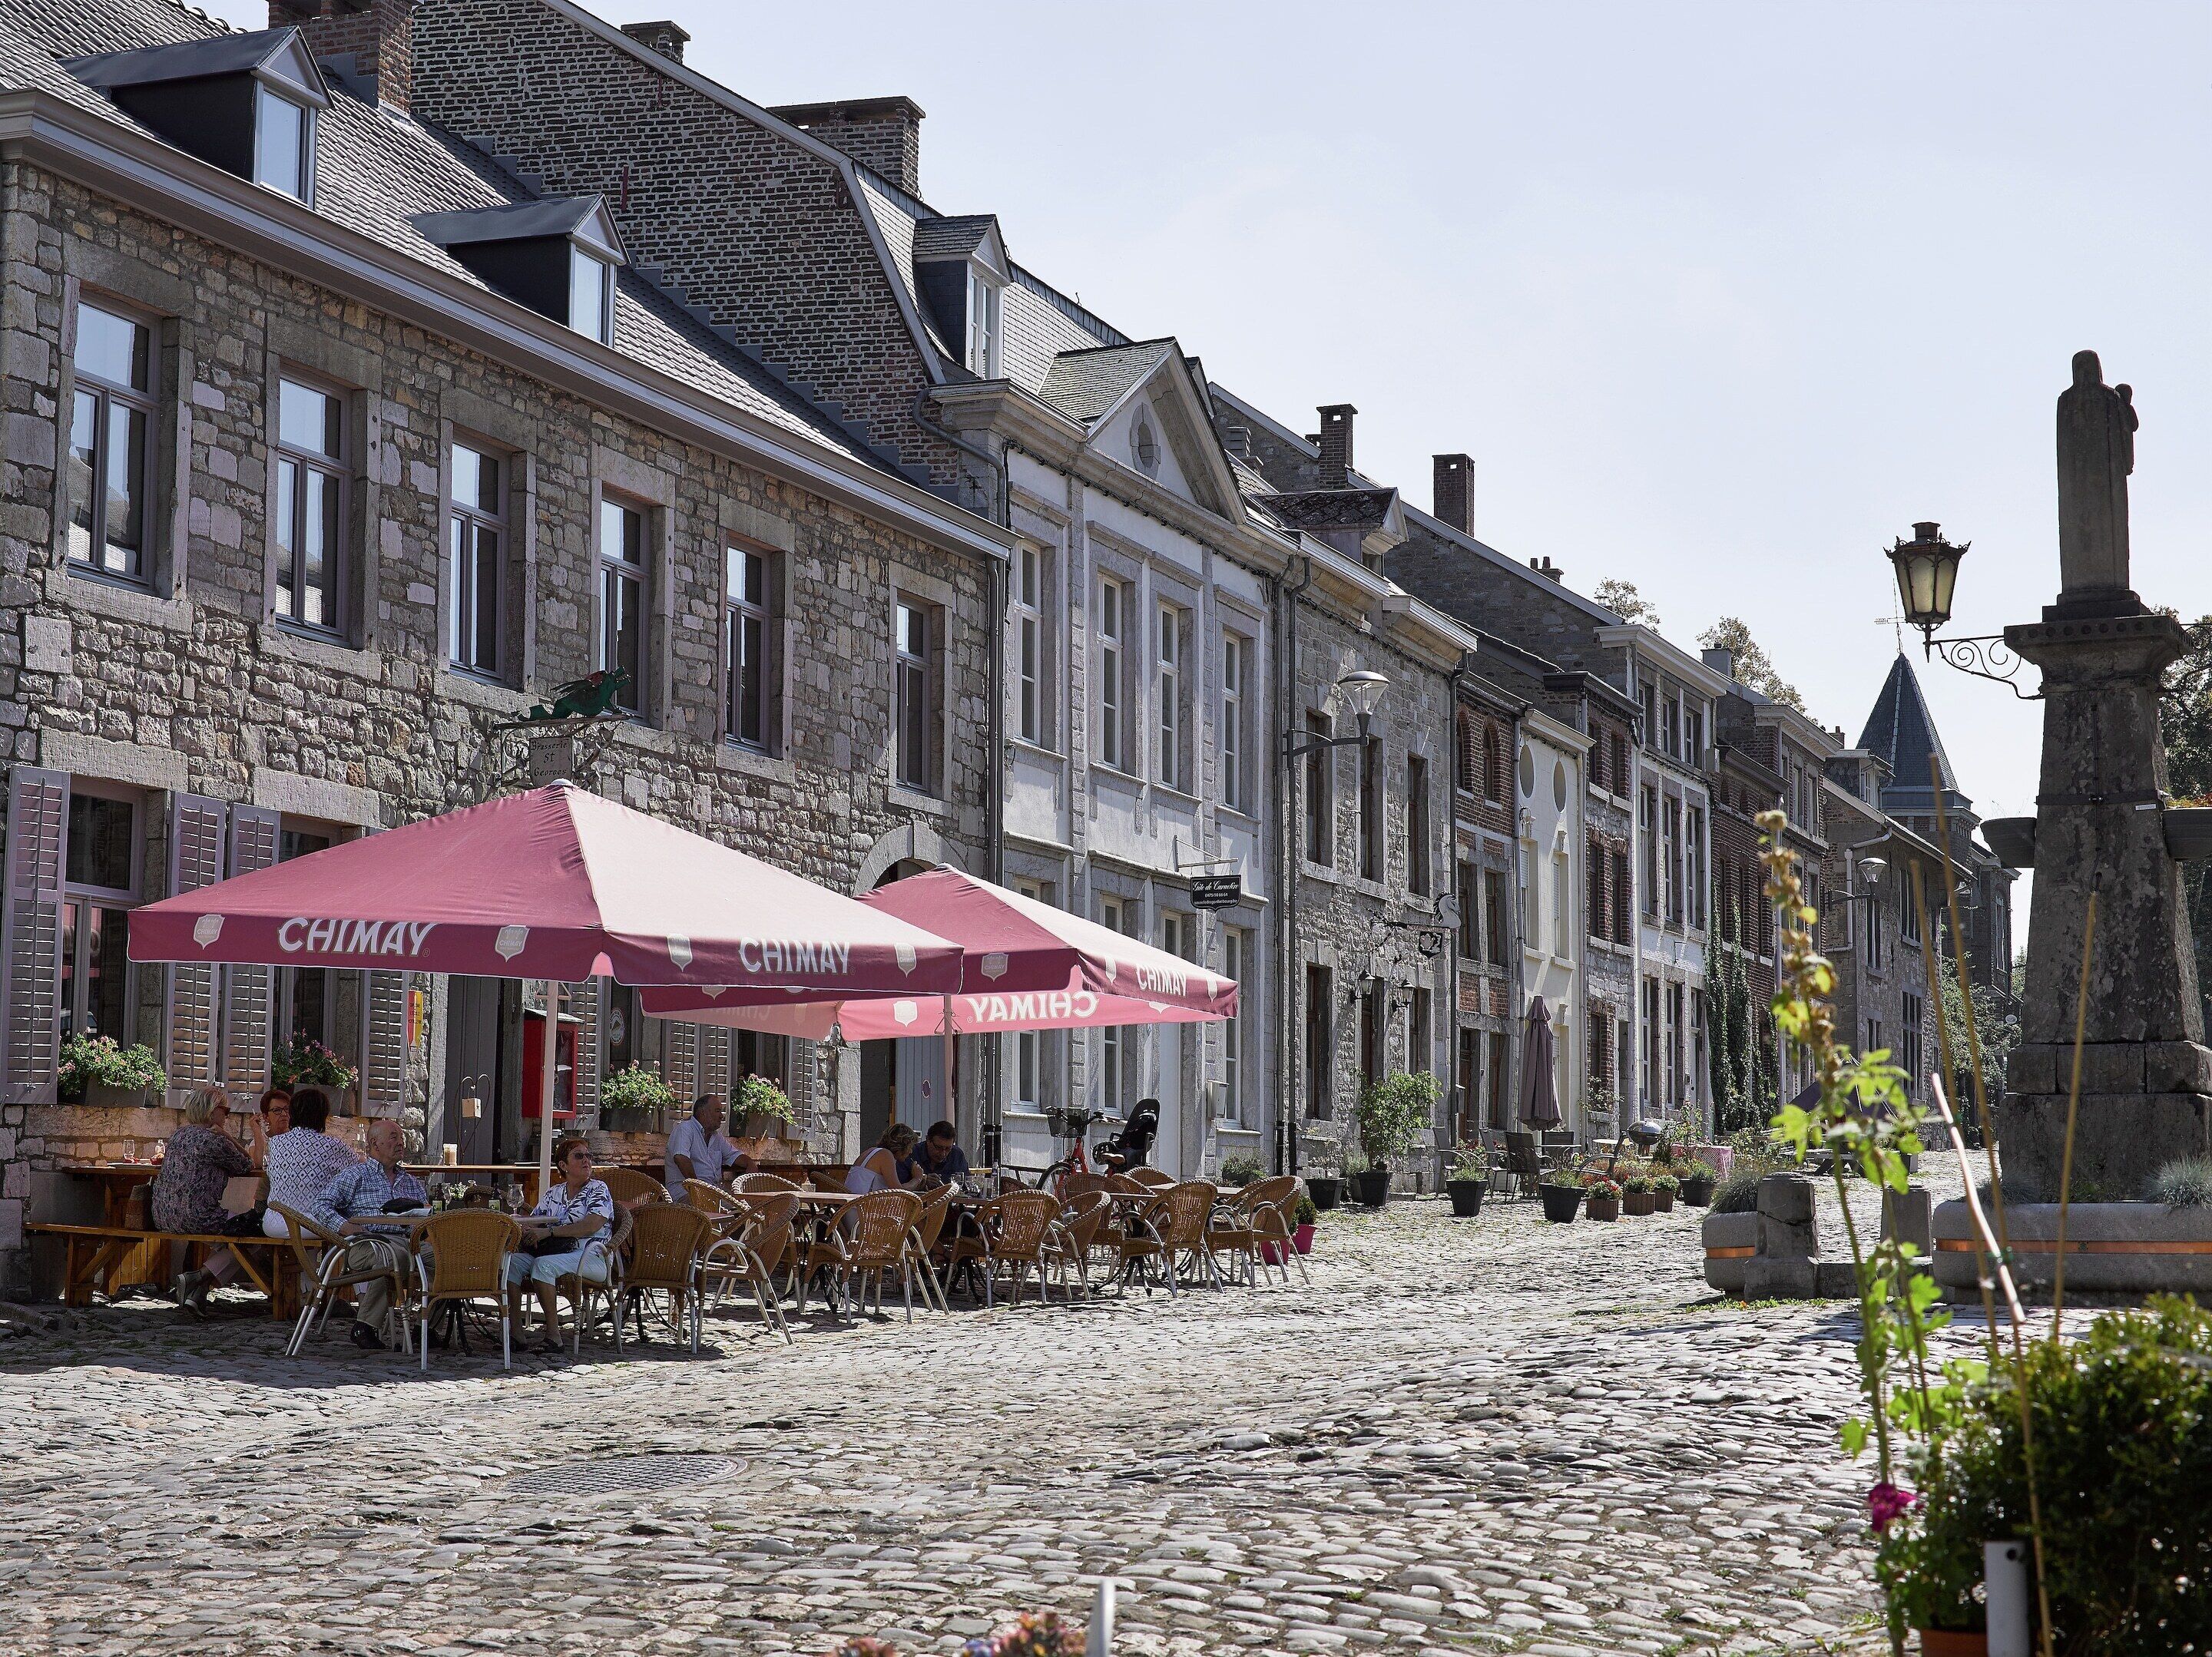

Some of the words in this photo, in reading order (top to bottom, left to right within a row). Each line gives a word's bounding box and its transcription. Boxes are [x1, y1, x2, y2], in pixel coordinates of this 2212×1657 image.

[531, 739, 568, 751] Brasserie
[544, 752, 555, 762] St
[534, 767, 567, 776] Georges
[1205, 881, 1213, 891] de
[278, 918, 438, 956] CHIMAY
[738, 937, 850, 974] CHIMAY
[1135, 965, 1187, 997] CHIMAY
